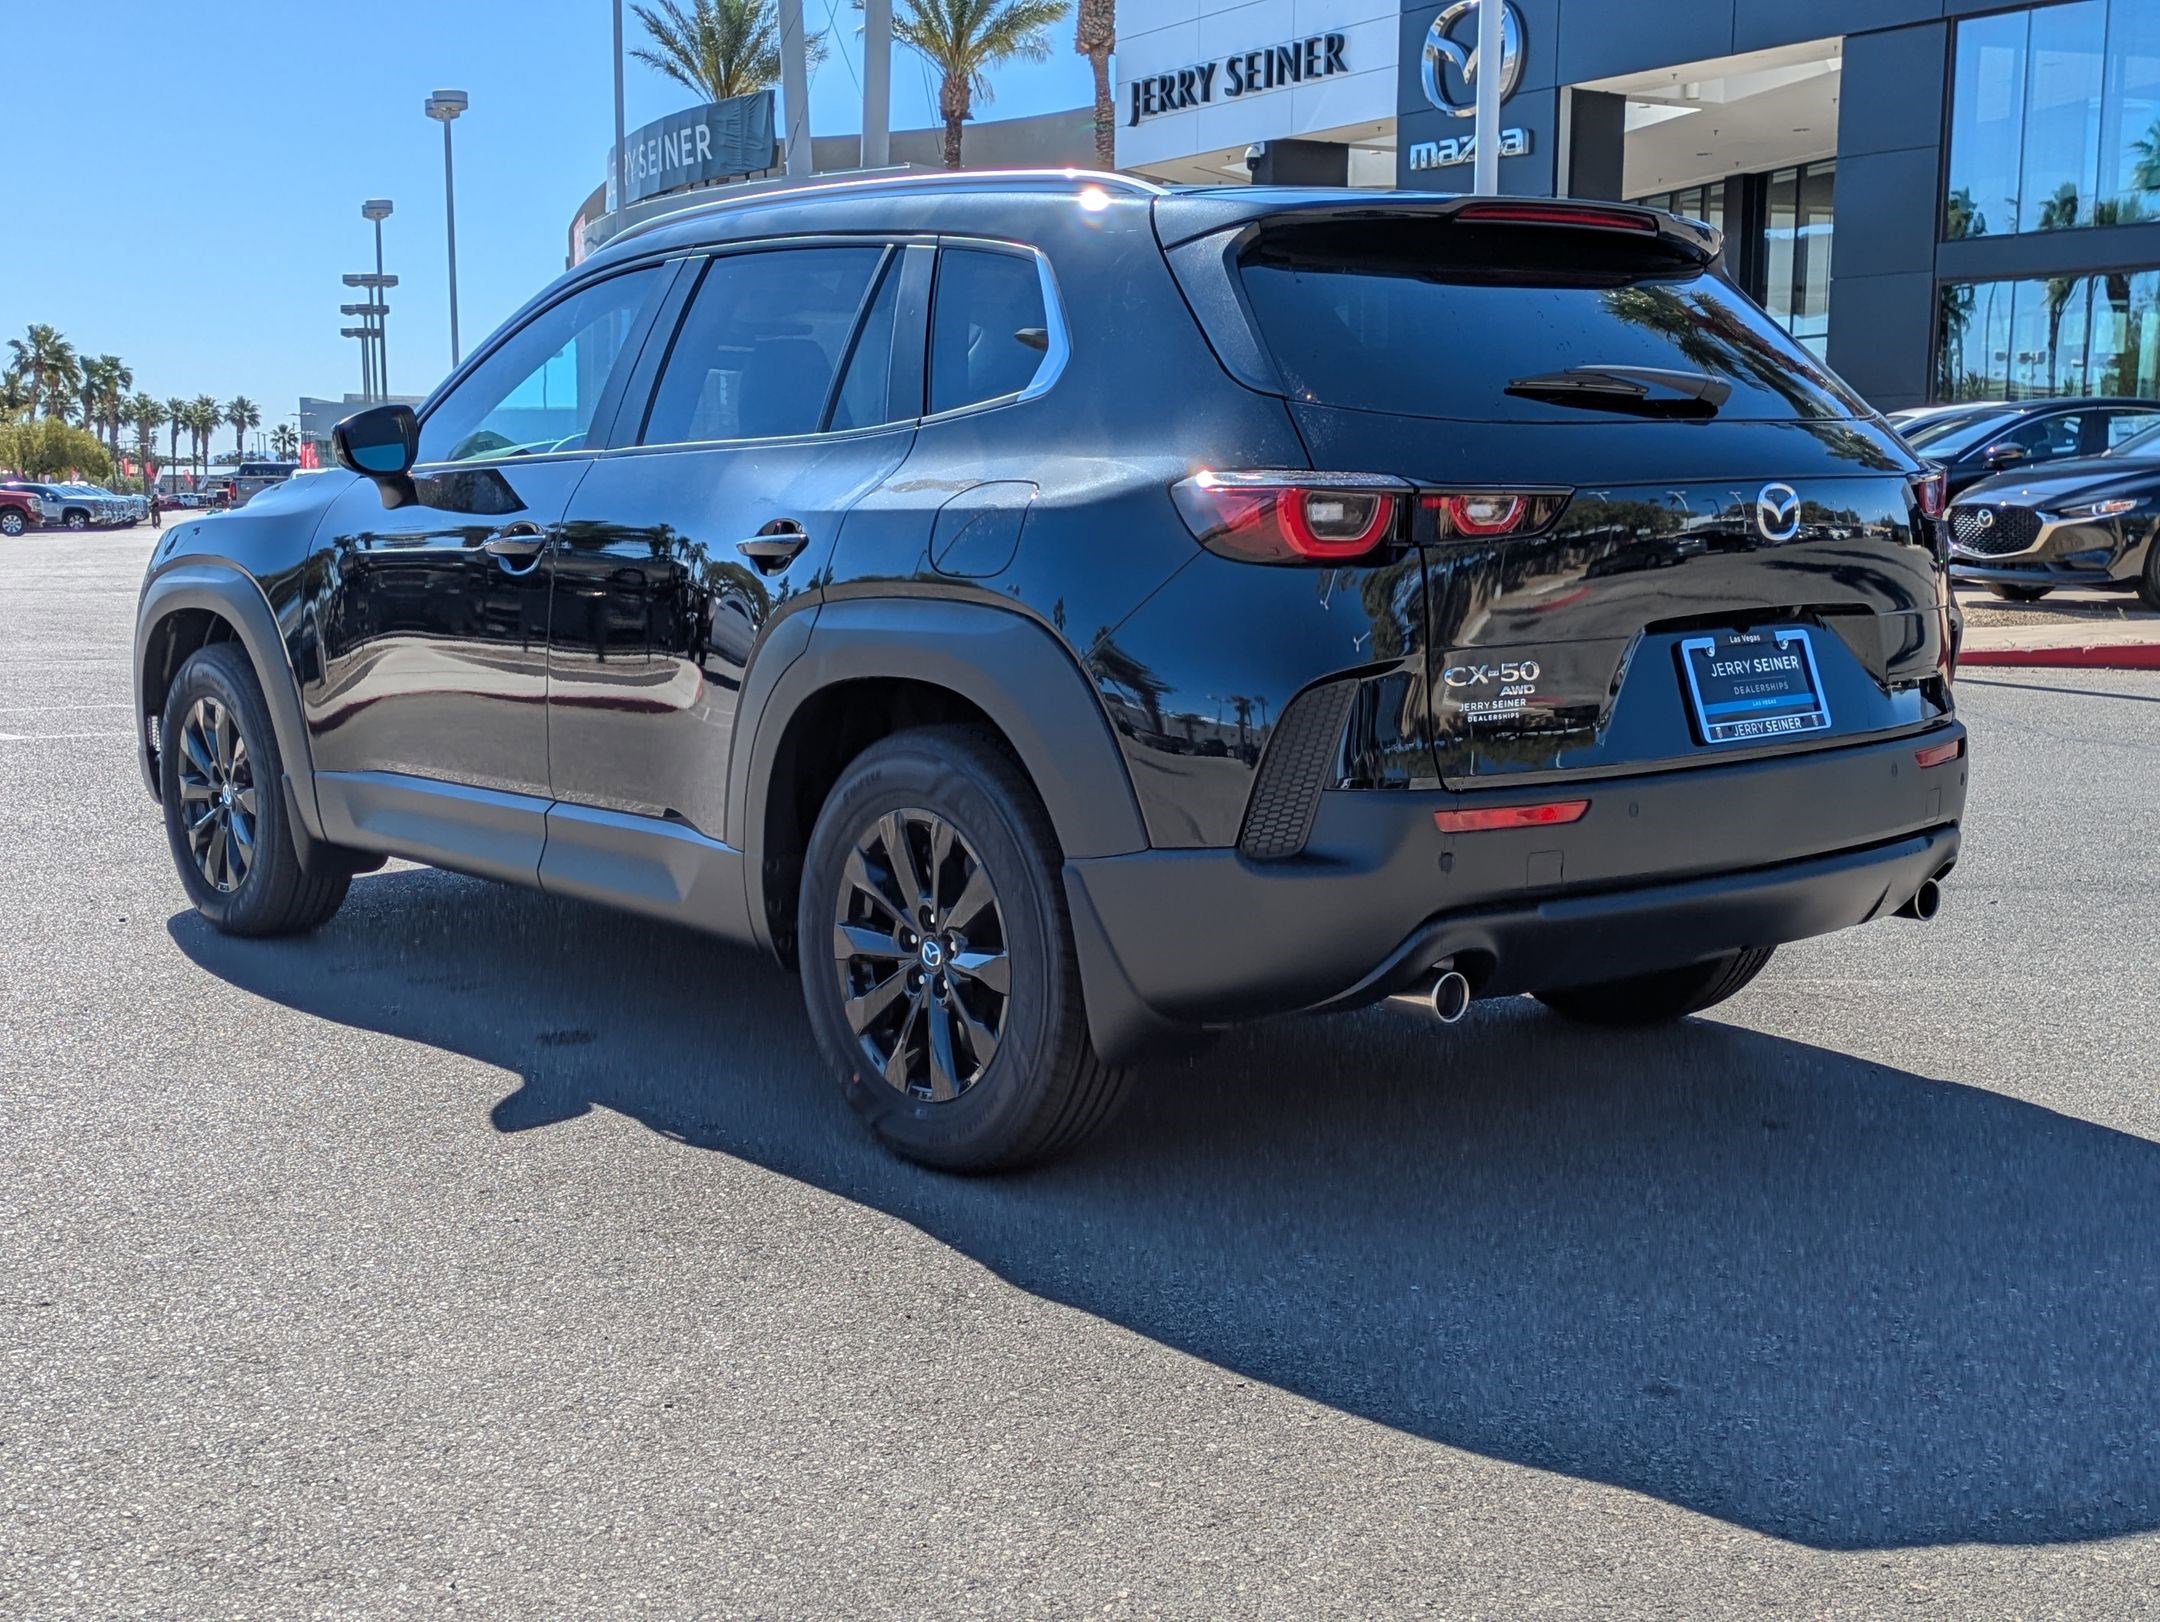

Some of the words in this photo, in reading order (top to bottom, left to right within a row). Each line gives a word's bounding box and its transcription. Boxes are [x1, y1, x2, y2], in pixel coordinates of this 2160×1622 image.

[1127, 62, 1217, 127] JERRY
[1223, 33, 1349, 97] SEINER
[639, 124, 713, 179] SEINER
[1409, 127, 1529, 170] maza
[1742, 634, 1760, 642] Vegas
[1443, 661, 1540, 687] CX-50
[1711, 659, 1751, 677] JERRY
[1753, 655, 1799, 672] SEINER
[1499, 684, 1535, 696] AWD
[1733, 681, 1789, 695] DEALERSHIPS
[1458, 702, 1490, 712] JERRY
[1492, 698, 1527, 709] SEINER
[1467, 712, 1520, 723] DEALERSHIPS
[1733, 722, 1764, 737] JERRY
[1765, 717, 1802, 733] SEINER
